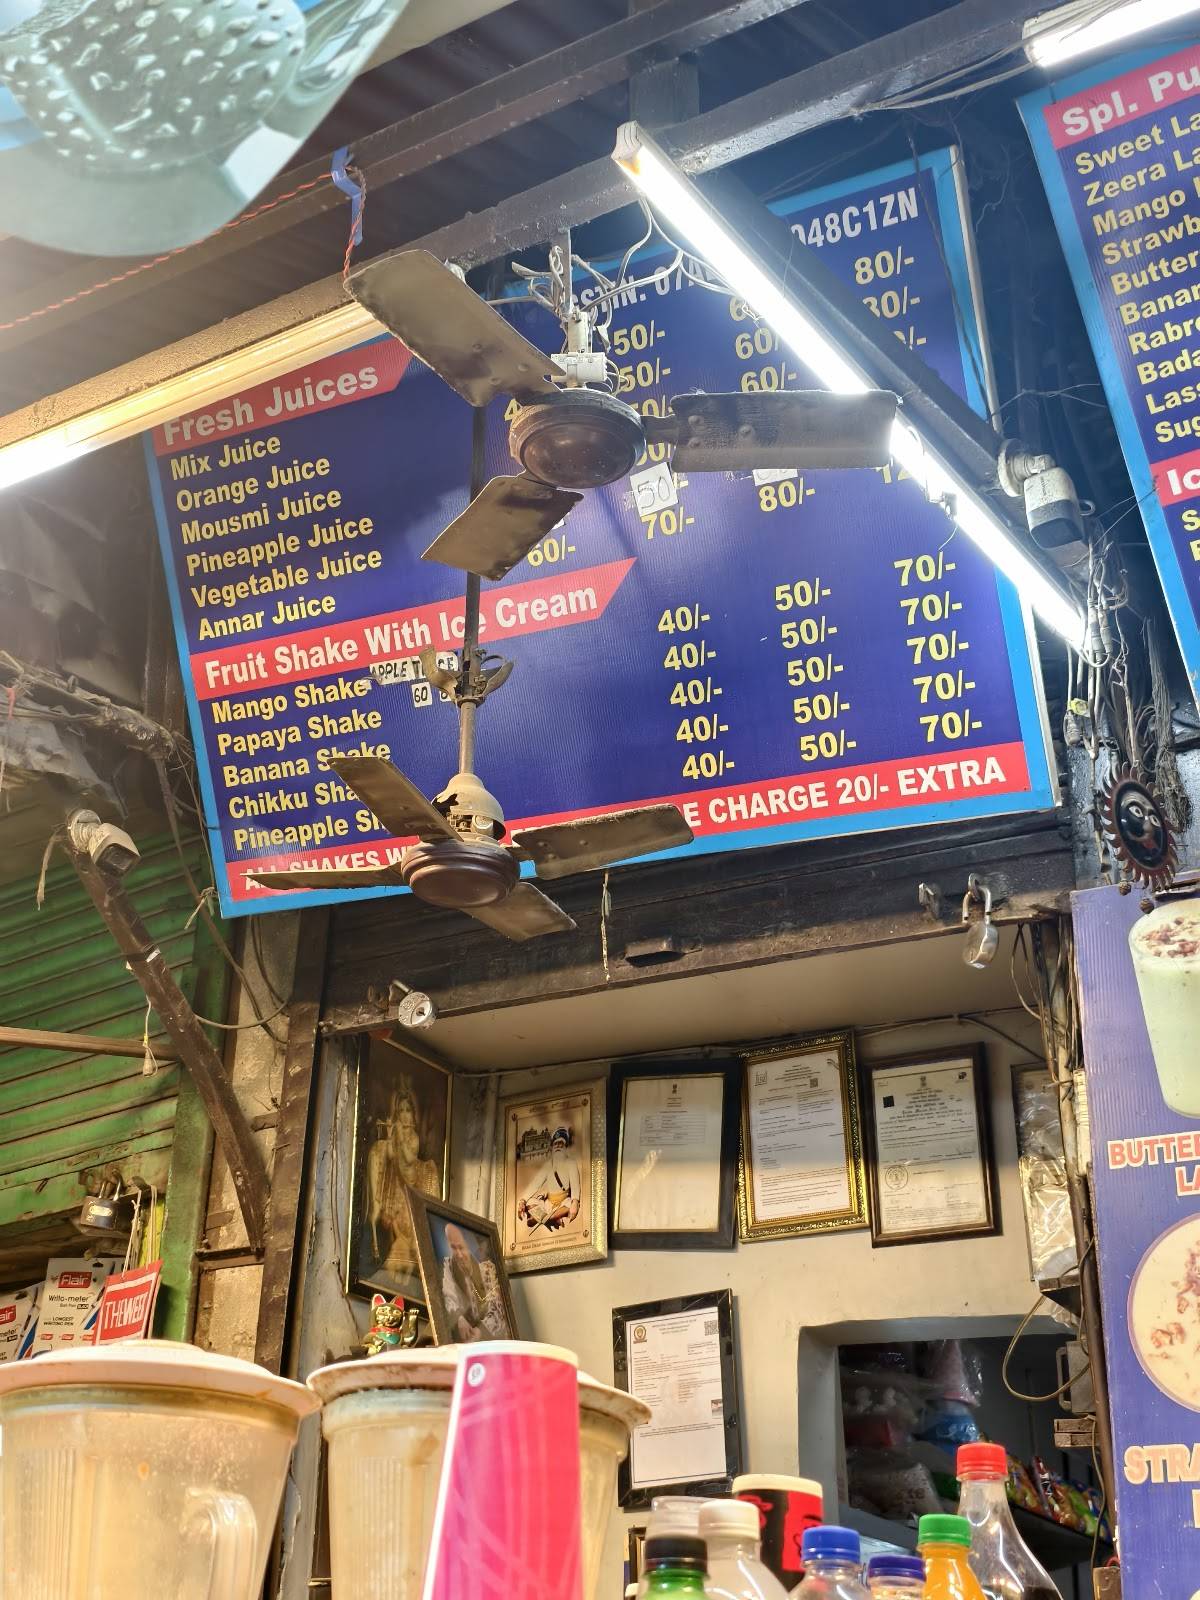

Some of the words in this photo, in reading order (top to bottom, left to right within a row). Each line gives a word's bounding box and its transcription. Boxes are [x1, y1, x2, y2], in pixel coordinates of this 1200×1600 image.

[1062, 90, 1139, 135] Spl.
[1075, 124, 1164, 175] Sweet
[1083, 163, 1167, 207] Zeera
[1092, 189, 1186, 236] Mango
[854, 245, 914, 285] 80/-
[1110, 249, 1200, 296] Butter
[613, 320, 666, 356] 50/-
[618, 357, 672, 393] 50/-
[163, 400, 254, 446] Fresh
[264, 366, 378, 417] Juices
[170, 454, 212, 481] Mix
[218, 436, 281, 468] Juice
[176, 476, 259, 512] Orange
[266, 457, 331, 489] Juice
[758, 477, 816, 512] 80/-
[181, 503, 270, 544] Mousmi
[277, 489, 342, 521] Juice
[641, 506, 695, 540] 70/-
[186, 533, 301, 577] Pineapple
[307, 517, 374, 548] Juice
[527, 534, 576, 567] 60/-
[191, 565, 309, 608] Vegetable
[316, 549, 382, 580] Juice
[658, 603, 710, 634] 40/-
[775, 577, 831, 611] 50/-
[894, 551, 956, 586] 70/-
[199, 609, 265, 641] Annar
[272, 595, 336, 625] Juice
[205, 653, 268, 689] Fruit
[274, 636, 360, 675] Shake
[364, 618, 432, 656] With
[495, 587, 598, 629] Cream
[663, 640, 716, 670] 40/-
[781, 616, 837, 649] 50/-
[900, 591, 962, 625] 70/-
[669, 677, 722, 707] 40/-
[787, 653, 843, 686] 50/-
[906, 630, 969, 665] 70/-
[211, 695, 288, 724] Mango
[294, 677, 368, 707] Shake
[414, 686, 428, 703] 60
[676, 713, 729, 744] 40/-
[793, 691, 850, 724] 50/-
[913, 670, 975, 704] 70/-
[217, 725, 302, 756] Papaya
[307, 709, 382, 739] Shake
[682, 750, 735, 780] 40/-
[800, 729, 856, 761] 50/-
[919, 709, 982, 742] 70/-
[223, 757, 311, 788] Banana
[709, 782, 829, 824] CHARGE
[837, 773, 889, 805] 20/-
[897, 757, 1006, 796] EXTRA
[228, 790, 309, 819] Chikku
[314, 781, 360, 805] Sha
[234, 815, 349, 851] Pineapple
[59, 1273, 89, 1286] Flair
